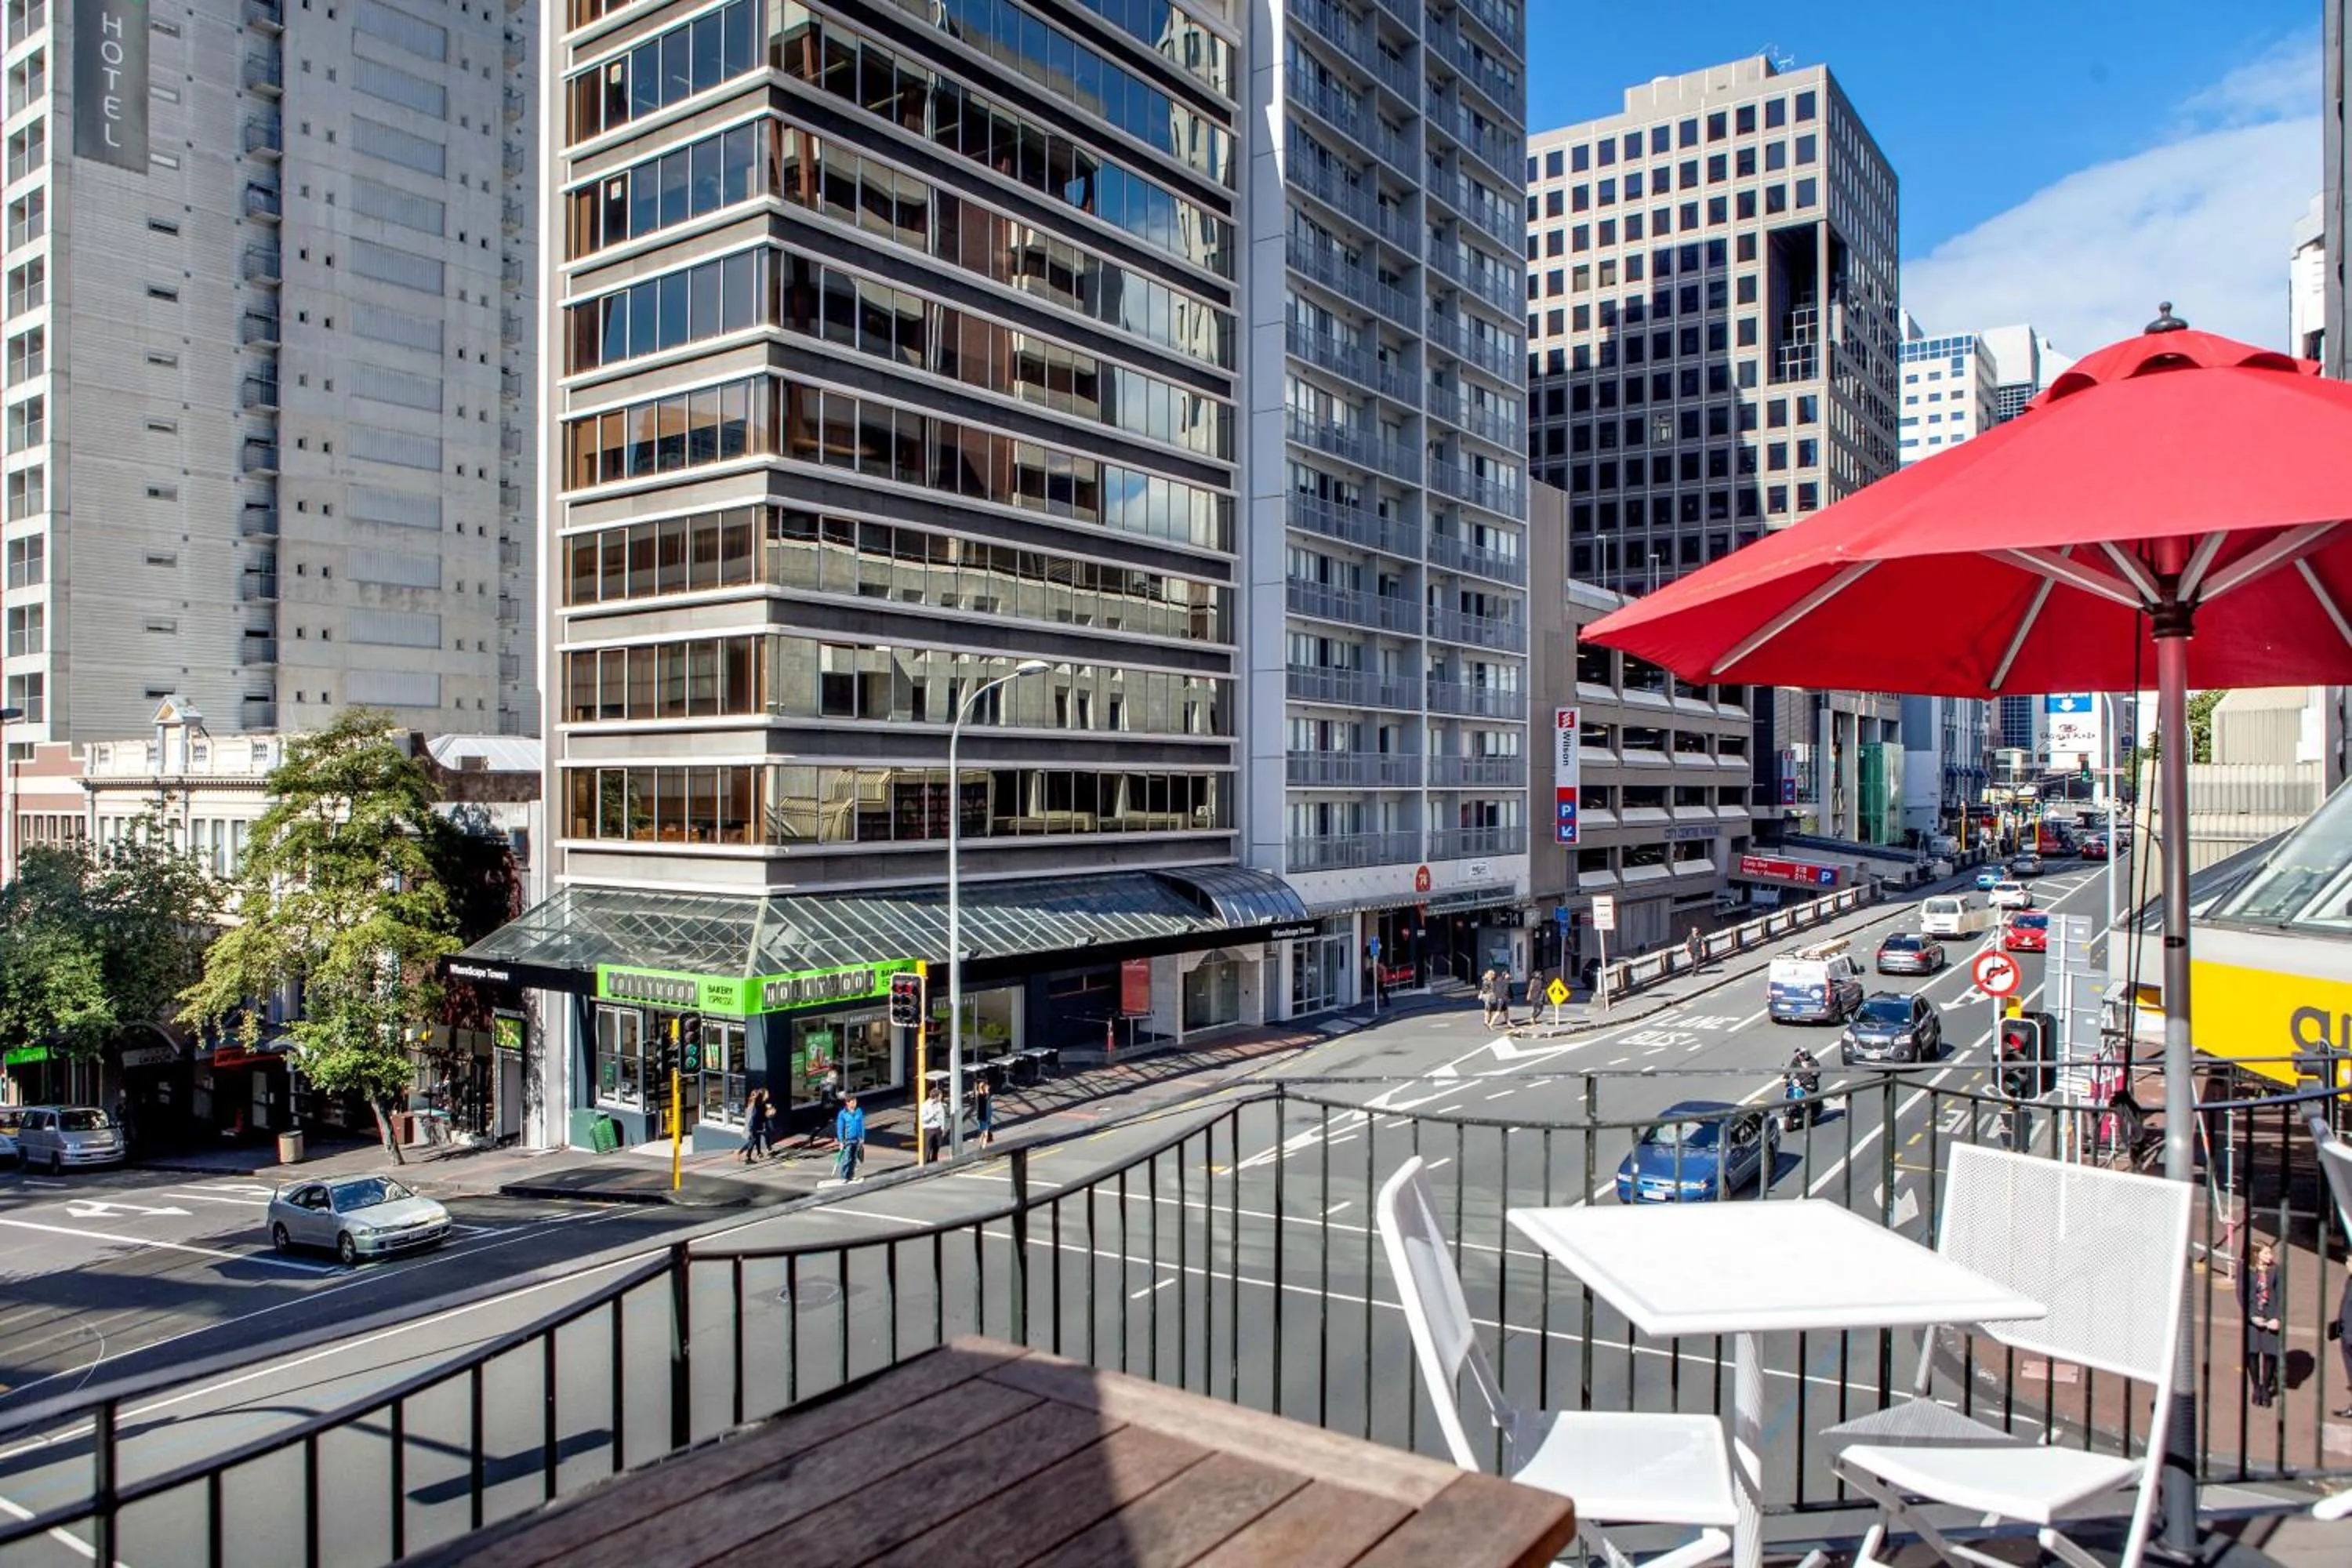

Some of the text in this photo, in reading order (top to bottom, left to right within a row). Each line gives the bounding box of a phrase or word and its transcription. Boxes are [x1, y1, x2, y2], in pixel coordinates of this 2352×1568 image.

[100, 11, 124, 148] HOTEL
[1563, 730, 1571, 766] Wilson
[1820, 870, 1832, 882] P
[707, 984, 733, 996] BAKERY
